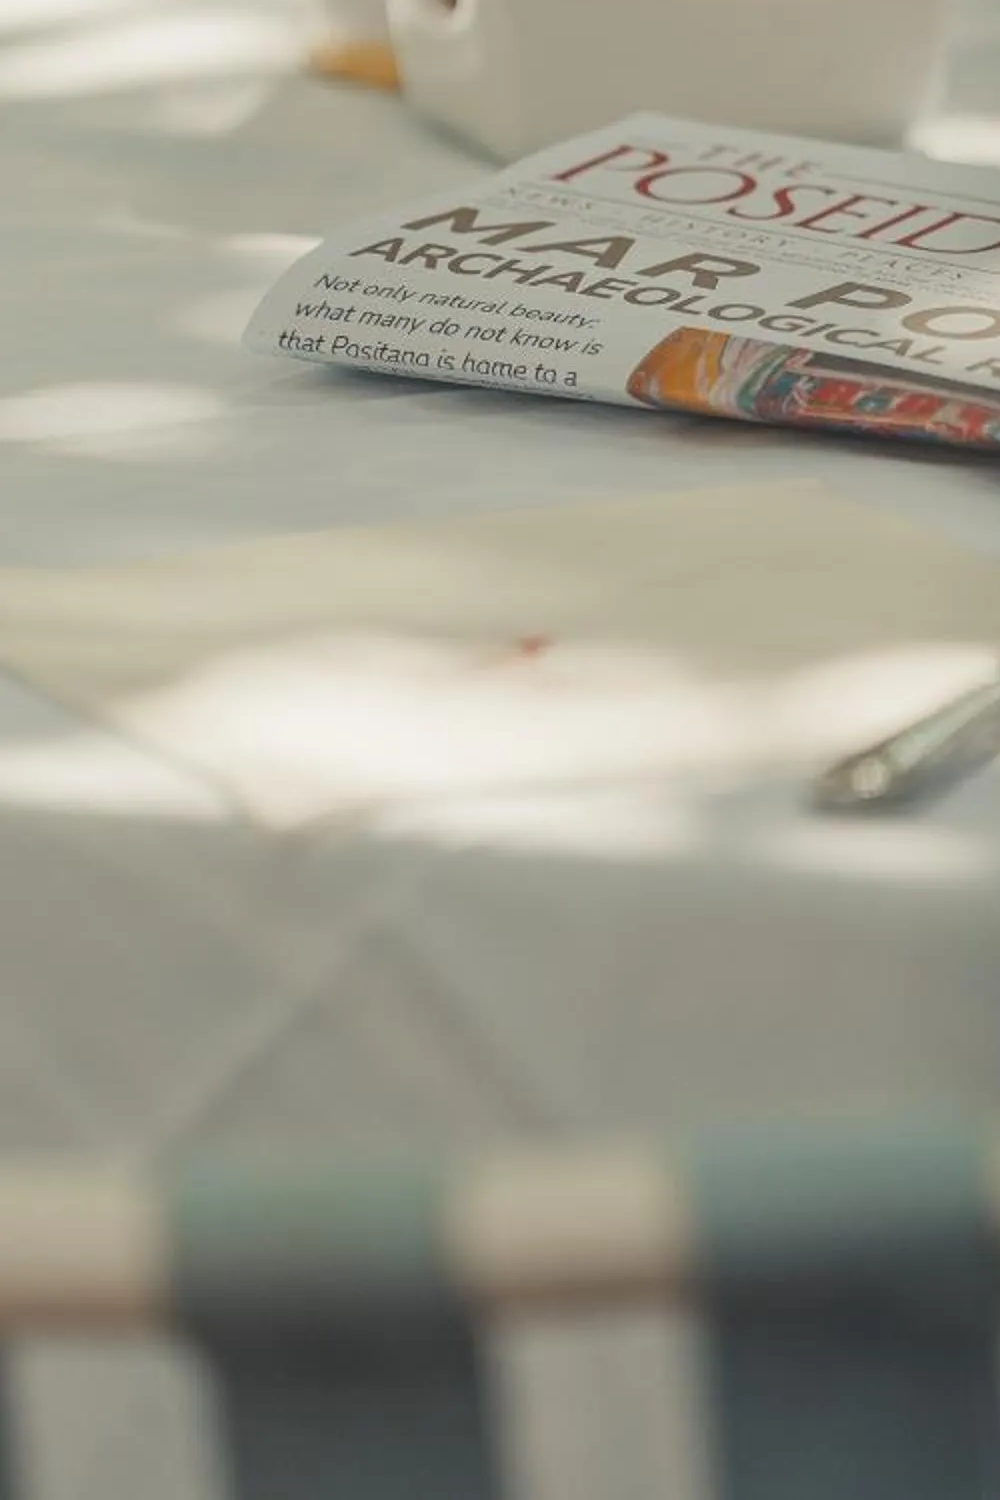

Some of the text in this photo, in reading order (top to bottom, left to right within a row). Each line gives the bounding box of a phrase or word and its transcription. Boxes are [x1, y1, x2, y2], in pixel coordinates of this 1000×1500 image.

[400, 206, 763, 291] MAR
[312, 273, 361, 293] Not
[362, 282, 415, 303] only
[418, 288, 508, 314] natural
[349, 237, 948, 366] ARCHAEOLOGICAL
[294, 301, 606, 358] what many do not know is
[276, 330, 327, 355] that
[329, 334, 432, 369] Positano
[435, 348, 456, 373] is
[460, 352, 529, 382] home
[532, 361, 560, 386] to
[562, 368, 579, 389] a
